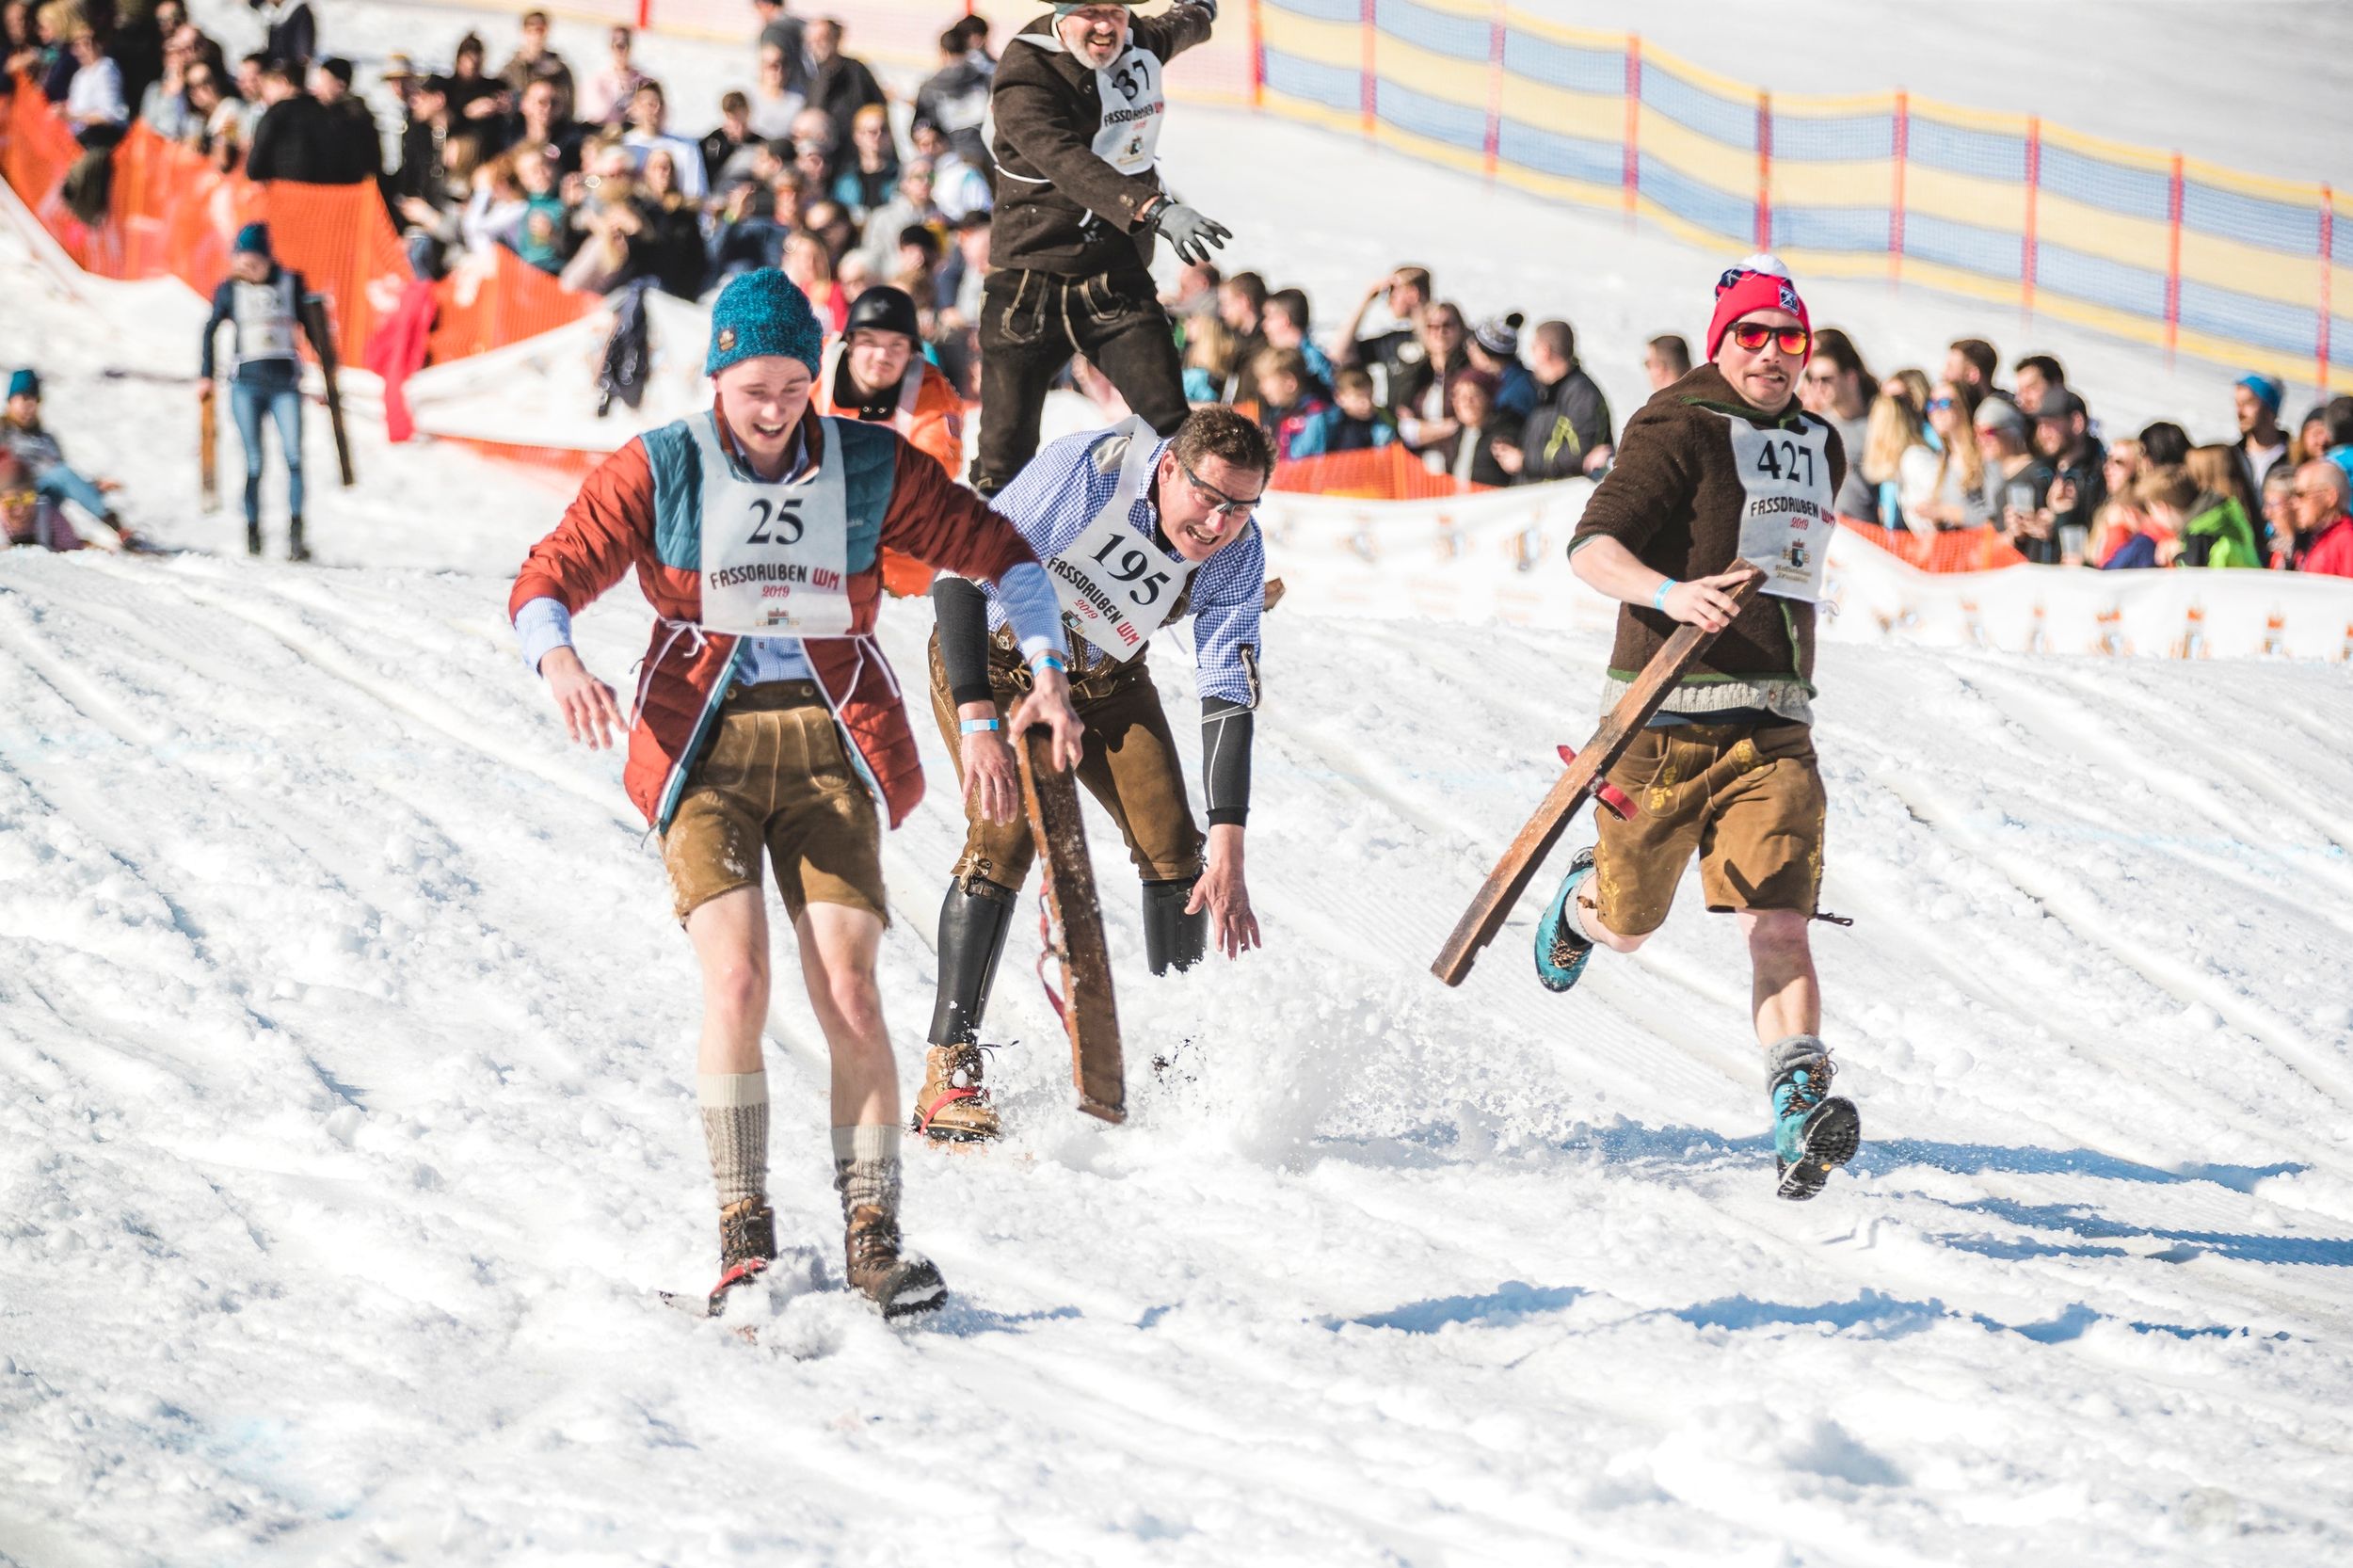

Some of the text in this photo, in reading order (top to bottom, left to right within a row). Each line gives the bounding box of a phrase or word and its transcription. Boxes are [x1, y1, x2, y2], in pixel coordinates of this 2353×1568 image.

[1104, 104, 1154, 127] FASSD
[1757, 440, 1814, 488] 427
[1751, 496, 1819, 518] FASSDAUBEN
[745, 498, 805, 545] 25
[1790, 517, 1809, 531] 2019
[710, 563, 840, 590] FASSDAUBEN WM
[1088, 533, 1172, 605] 195
[761, 584, 791, 598] 2019
[1047, 557, 1140, 647] FASSDAUBEN WM
[1073, 599, 1098, 620] 2019
